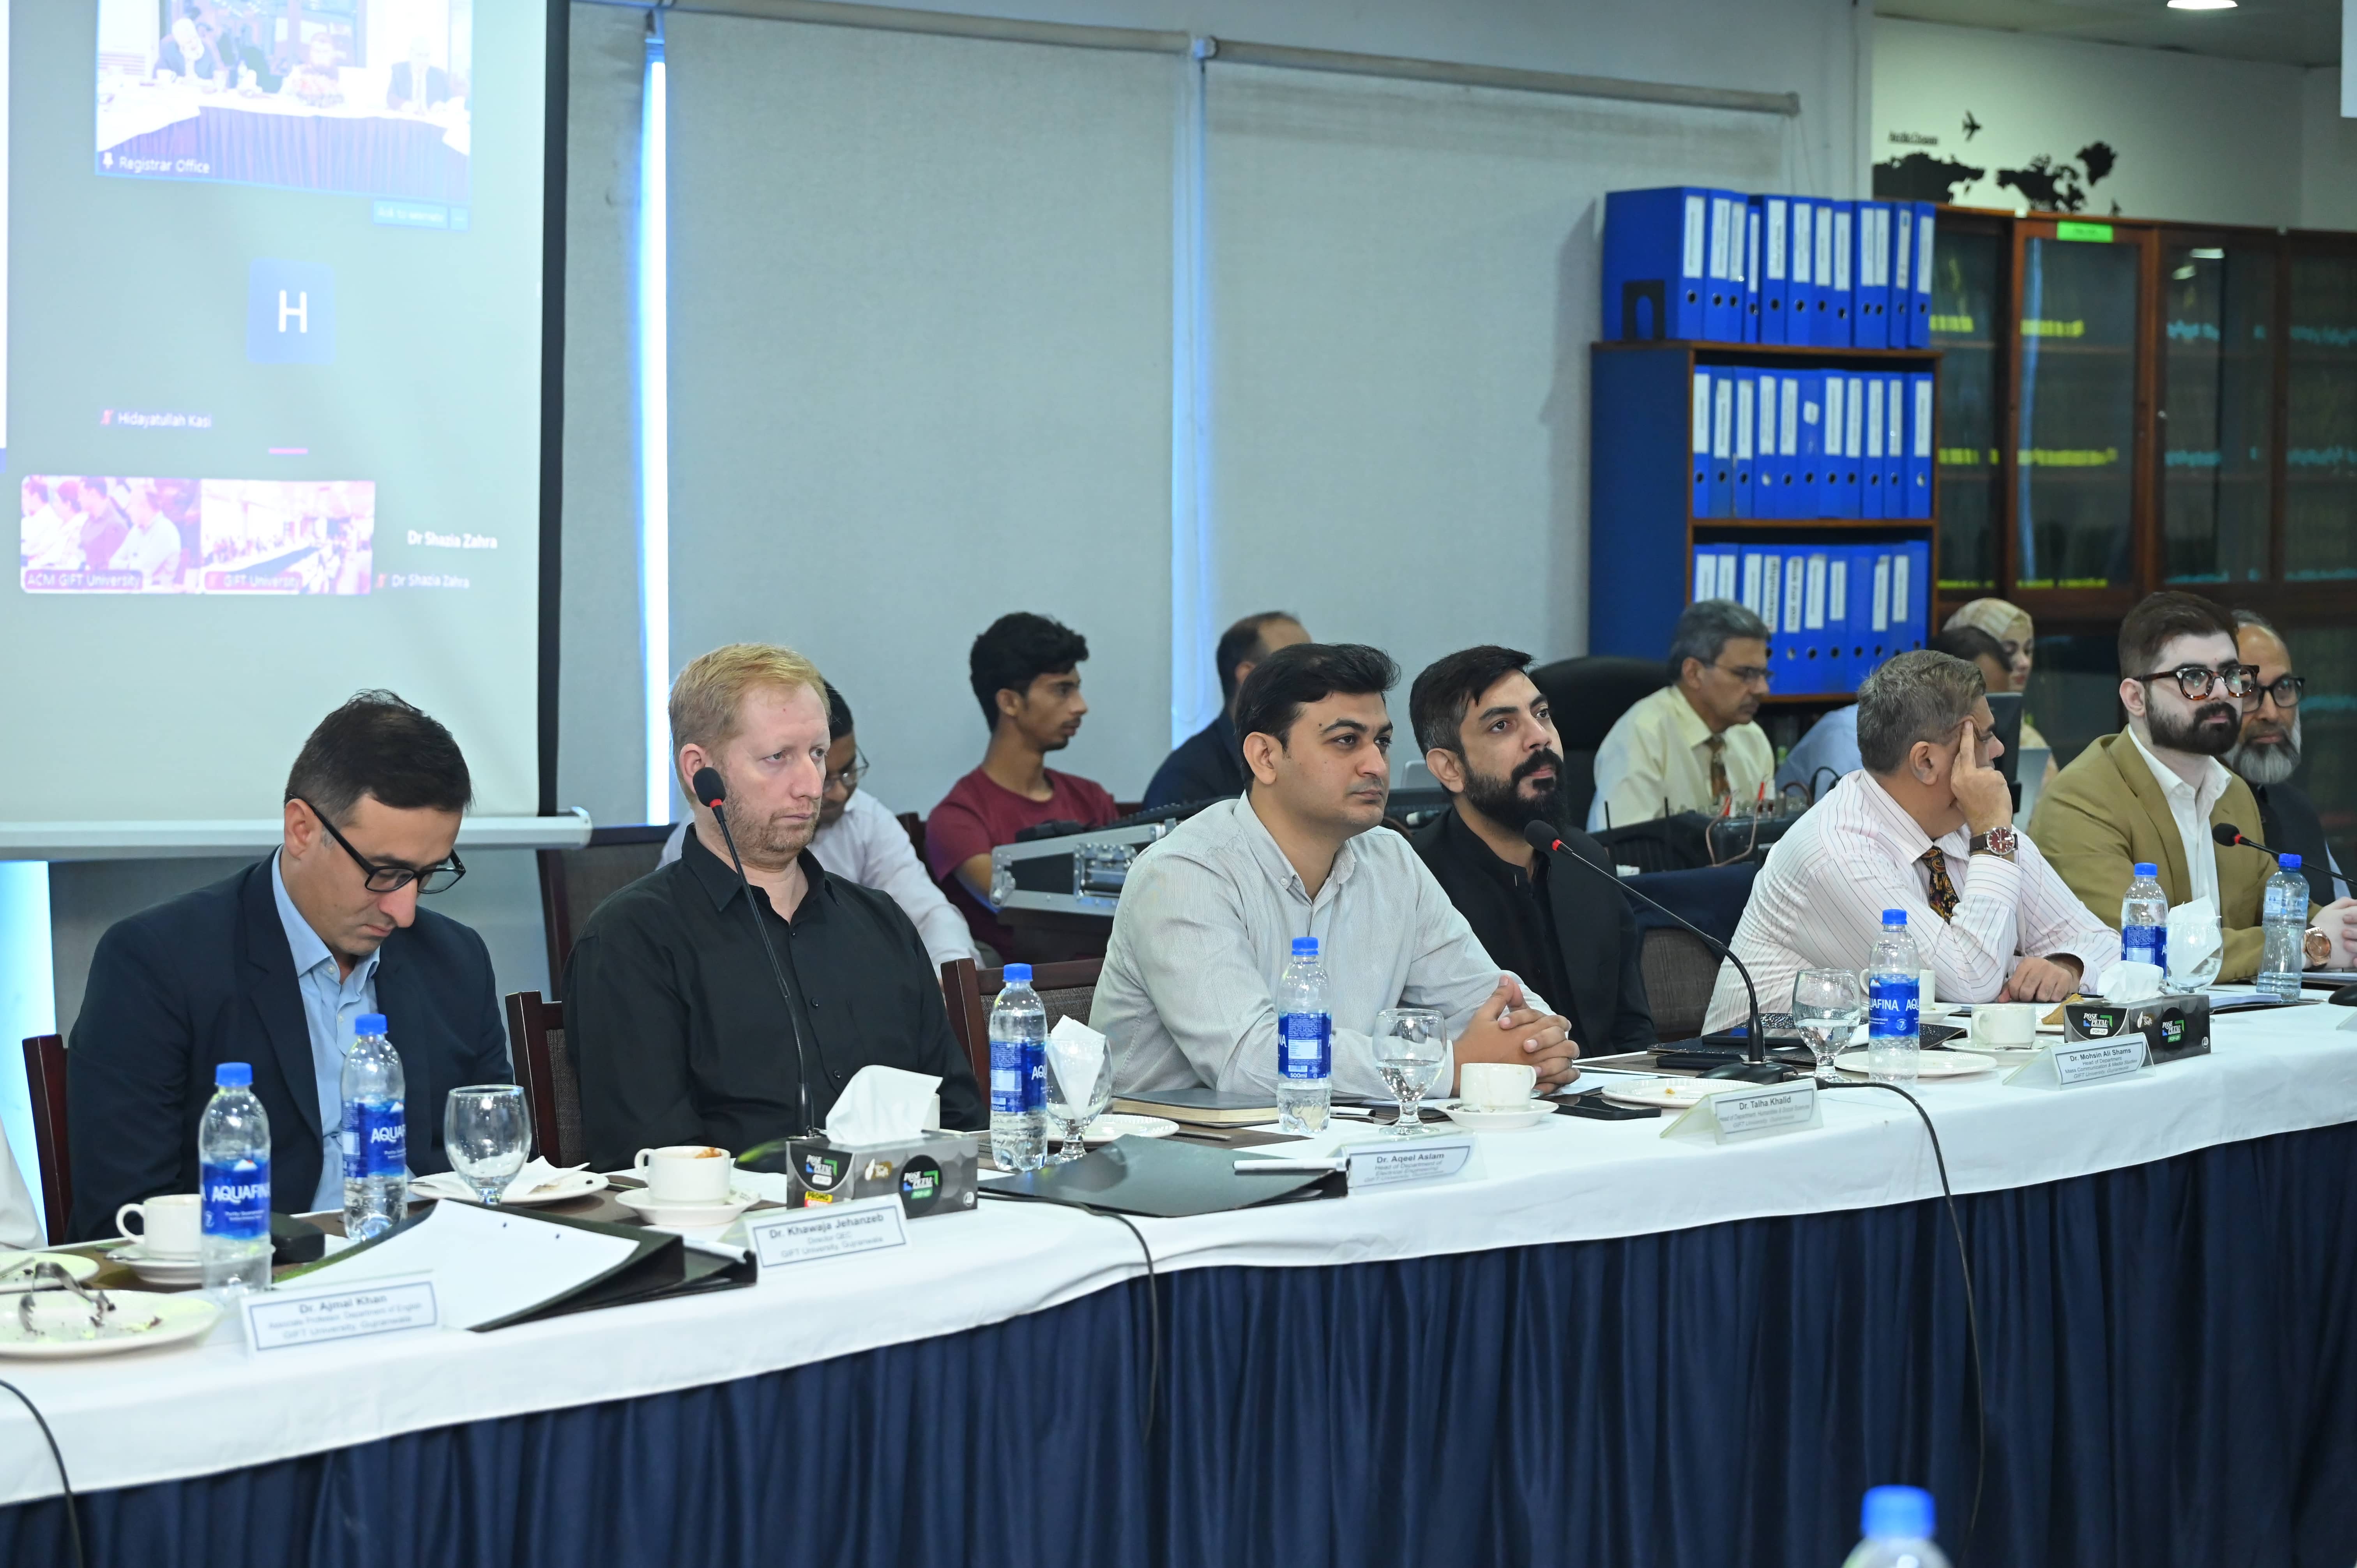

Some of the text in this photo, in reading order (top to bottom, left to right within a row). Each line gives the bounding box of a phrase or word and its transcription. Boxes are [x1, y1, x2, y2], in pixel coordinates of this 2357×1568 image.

[119, 156, 210, 174] Registrar Office
[279, 290, 307, 333] H
[118, 411, 186, 429] Hidayatullah
[408, 530, 498, 549] Dr Shazia Zahra
[27, 574, 141, 588] ACM GIFT University
[392, 574, 406, 588] Dr
[408, 574, 441, 586] Shazia
[2083, 1013, 2098, 1021] ROSE
[2144, 1017, 2152, 1026] Soft
[1899, 1021, 1905, 1029] 7
[2162, 1021, 2173, 1029] ROSE
[2168, 1024, 2181, 1035] PETAL
[2080, 1052, 2102, 1060] Mohsin
[2100, 1056, 2122, 1065] Department
[2077, 1064, 2107, 1072] Communication
[1750, 1100, 1768, 1109] Talha
[1770, 1095, 1792, 1106] Khalid
[1391, 1155, 1415, 1164] Aqeel
[1400, 1161, 1435, 1169] Department
[1404, 1166, 1439, 1174] Engineering
[903, 1171, 922, 1183] ROSE
[807, 1191, 829, 1201] PROMO
[769, 1213, 884, 1239] Dr. Khawaja Jehanzeb
[807, 1234, 835, 1244] Director
[781, 1249, 800, 1258] GIFT
[299, 1294, 387, 1314] Dr. Ajmal Khan
